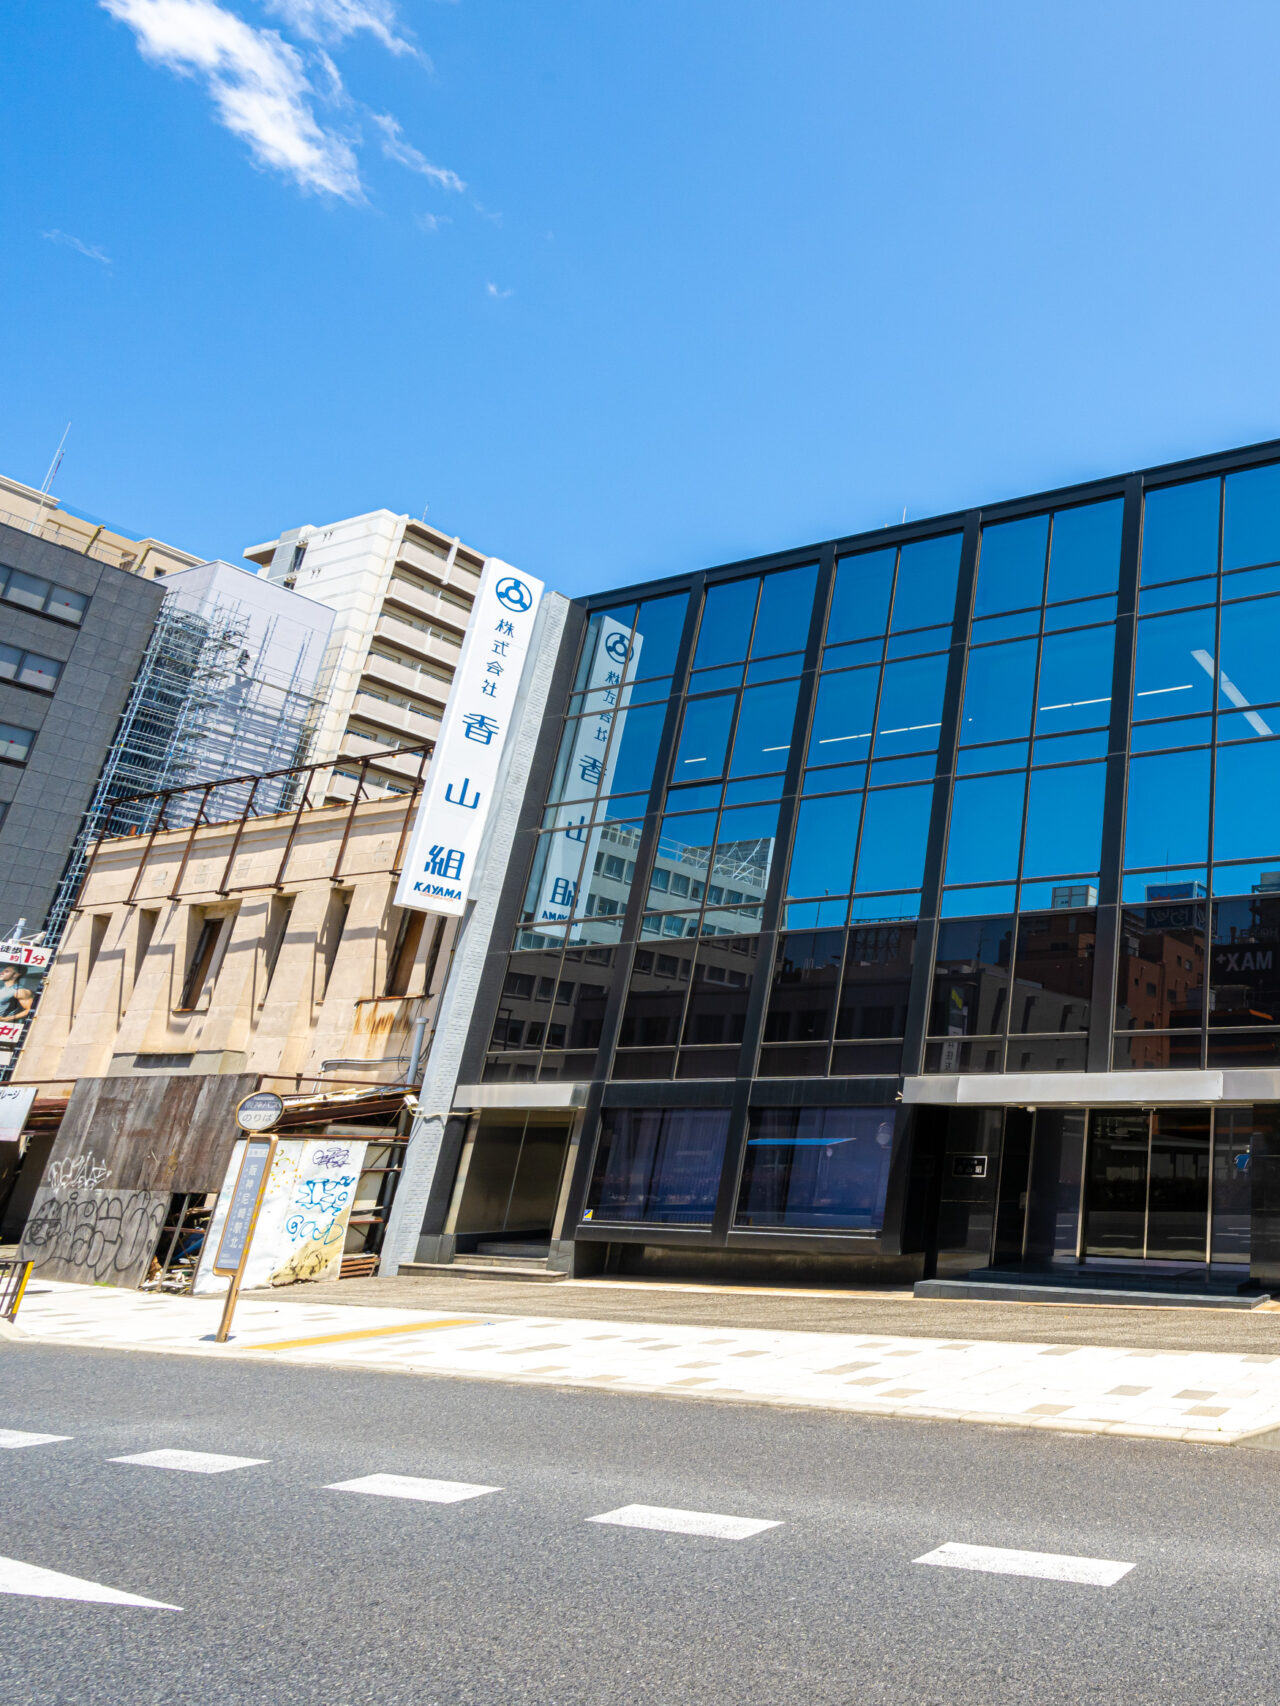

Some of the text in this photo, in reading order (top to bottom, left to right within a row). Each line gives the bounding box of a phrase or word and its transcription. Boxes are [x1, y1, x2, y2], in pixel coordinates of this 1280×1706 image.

[481, 618, 515, 698] 株式会社
[424, 712, 500, 881] 香山組
[413, 881, 462, 900] KAYAMA
[0, 1089, 21, 1100] レージ
[242, 1113, 274, 1122] のりば
